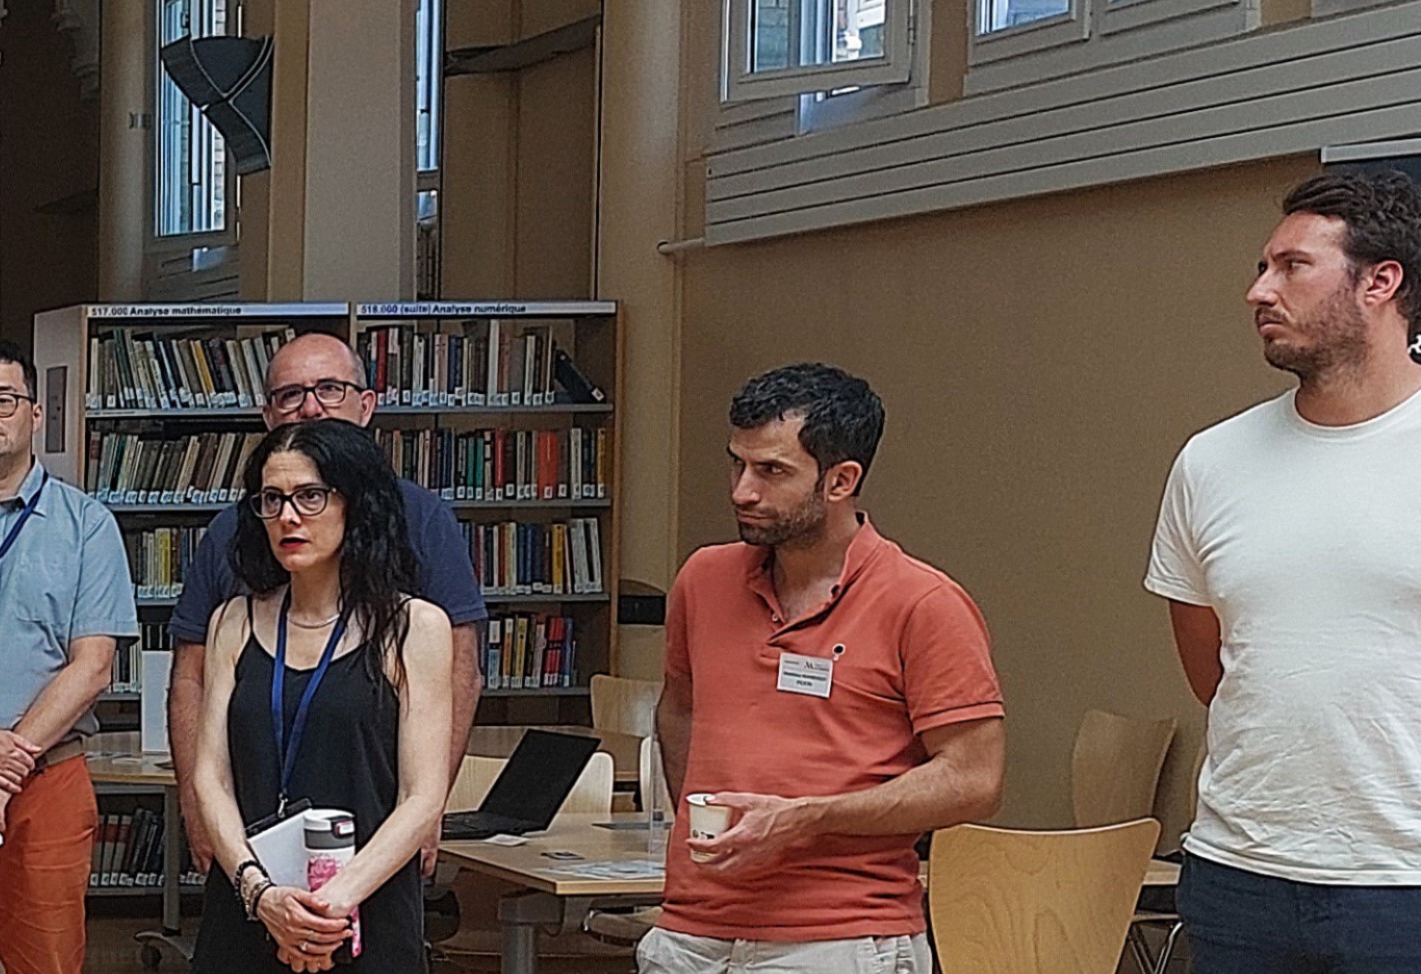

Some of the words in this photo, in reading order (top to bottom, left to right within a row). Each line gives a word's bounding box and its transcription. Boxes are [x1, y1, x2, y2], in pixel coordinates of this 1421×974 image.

[130, 306, 169, 317] Analyse
[432, 304, 472, 316] Analyse
[474, 303, 527, 315] numérique
